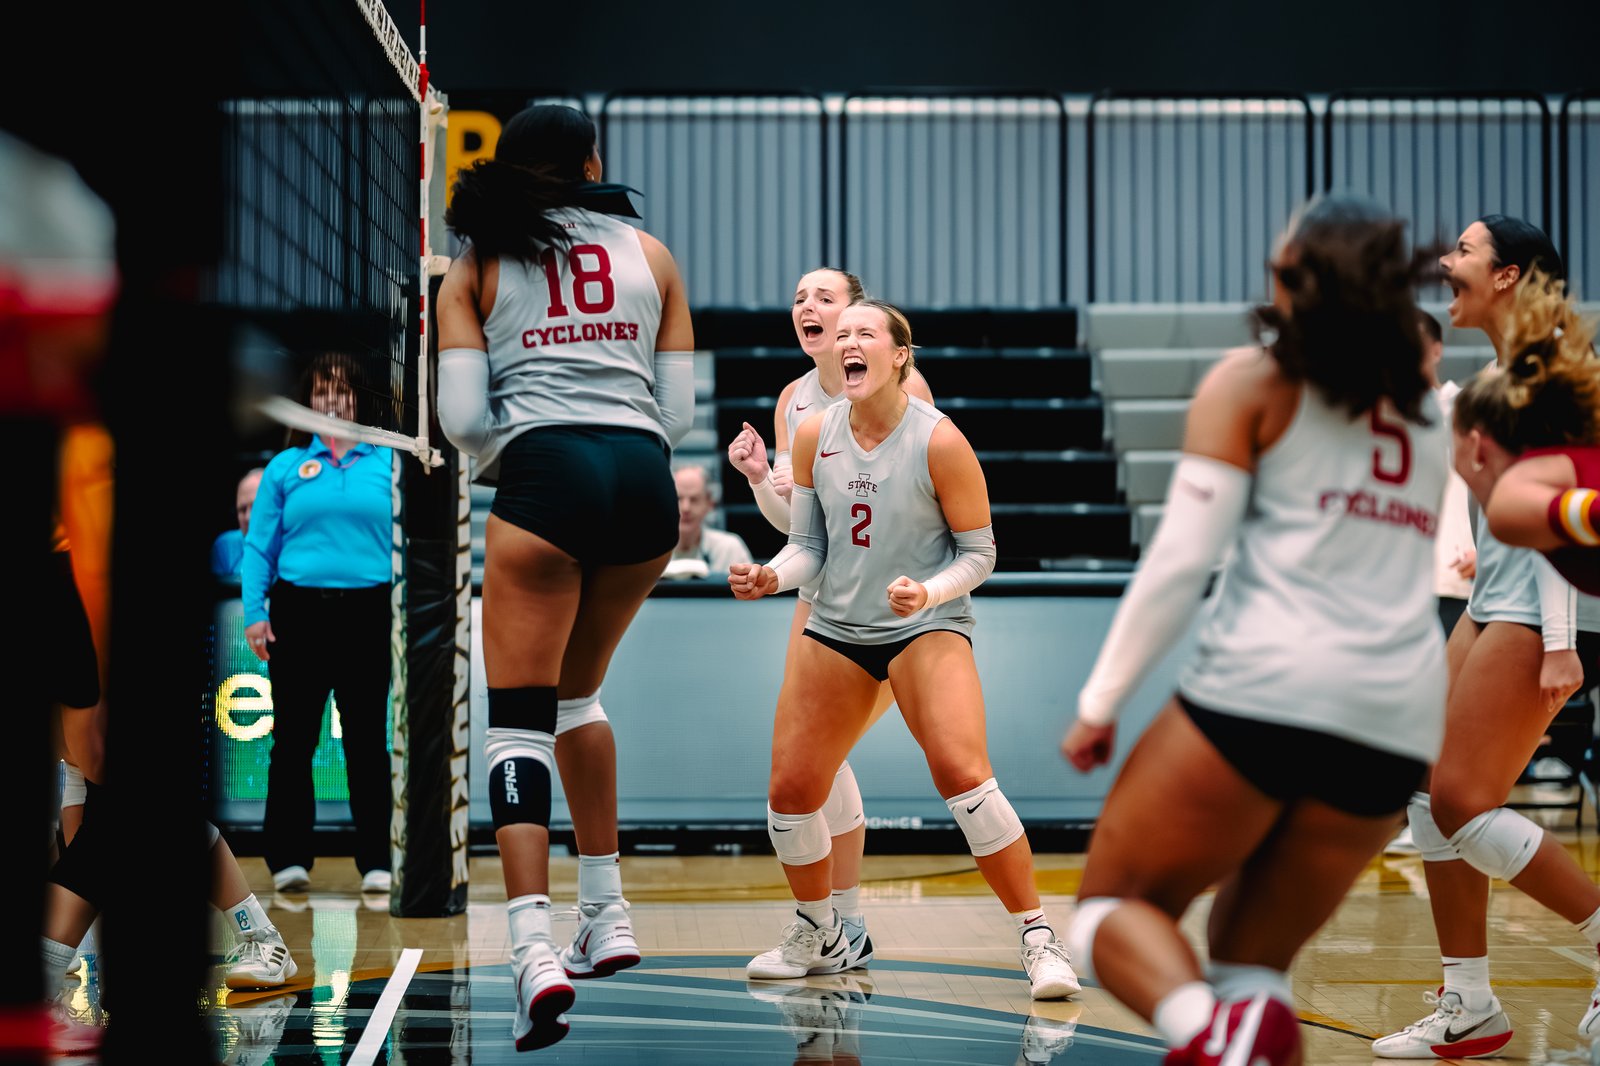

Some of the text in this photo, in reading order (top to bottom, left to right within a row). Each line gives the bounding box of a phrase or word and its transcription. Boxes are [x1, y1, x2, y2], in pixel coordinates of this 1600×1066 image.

[540, 244, 615, 317] 18
[522, 321, 639, 348] CYCLONES
[1369, 400, 1411, 486] 5
[847, 480, 878, 493] STATE
[851, 503, 872, 548] 2
[865, 816, 922, 829] ONICS
